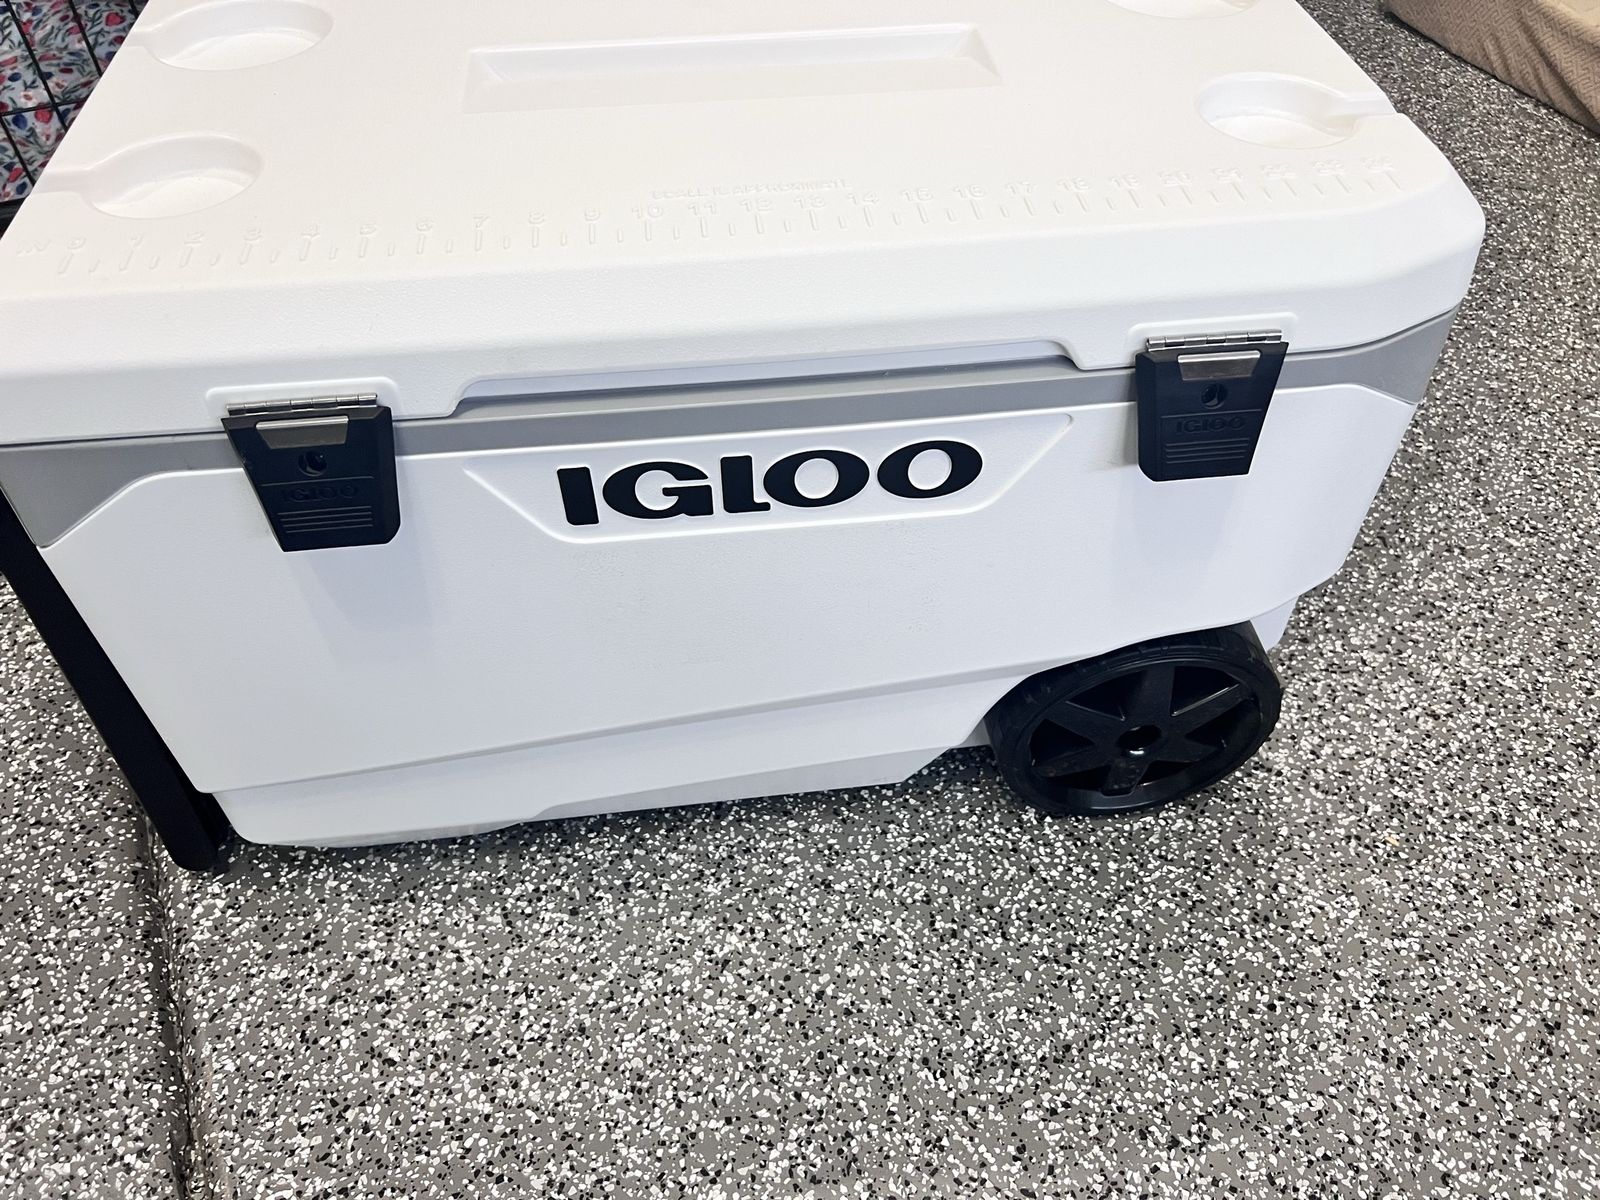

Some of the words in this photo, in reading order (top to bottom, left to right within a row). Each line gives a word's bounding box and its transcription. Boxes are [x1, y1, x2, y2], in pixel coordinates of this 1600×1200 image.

[243, 228, 263, 242] 3
[473, 213, 490, 228] 7
[528, 210, 546, 224] 8
[584, 207, 601, 221] 9
[631, 205, 665, 219] 10
[688, 202, 717, 215] 11
[739, 199, 774, 212] 12
[793, 196, 827, 210] 13
[845, 191, 878, 206] 14
[901, 187, 934, 201] 15
[953, 184, 987, 199] 16
[1004, 180, 1036, 196] 17
[1056, 177, 1091, 192] 18
[1108, 174, 1141, 189] 19
[1156, 170, 1193, 187] 20
[1209, 167, 1244, 183] 21
[1175, 416, 1247, 434] IGLOO
[557, 440, 983, 526] IGLOO
